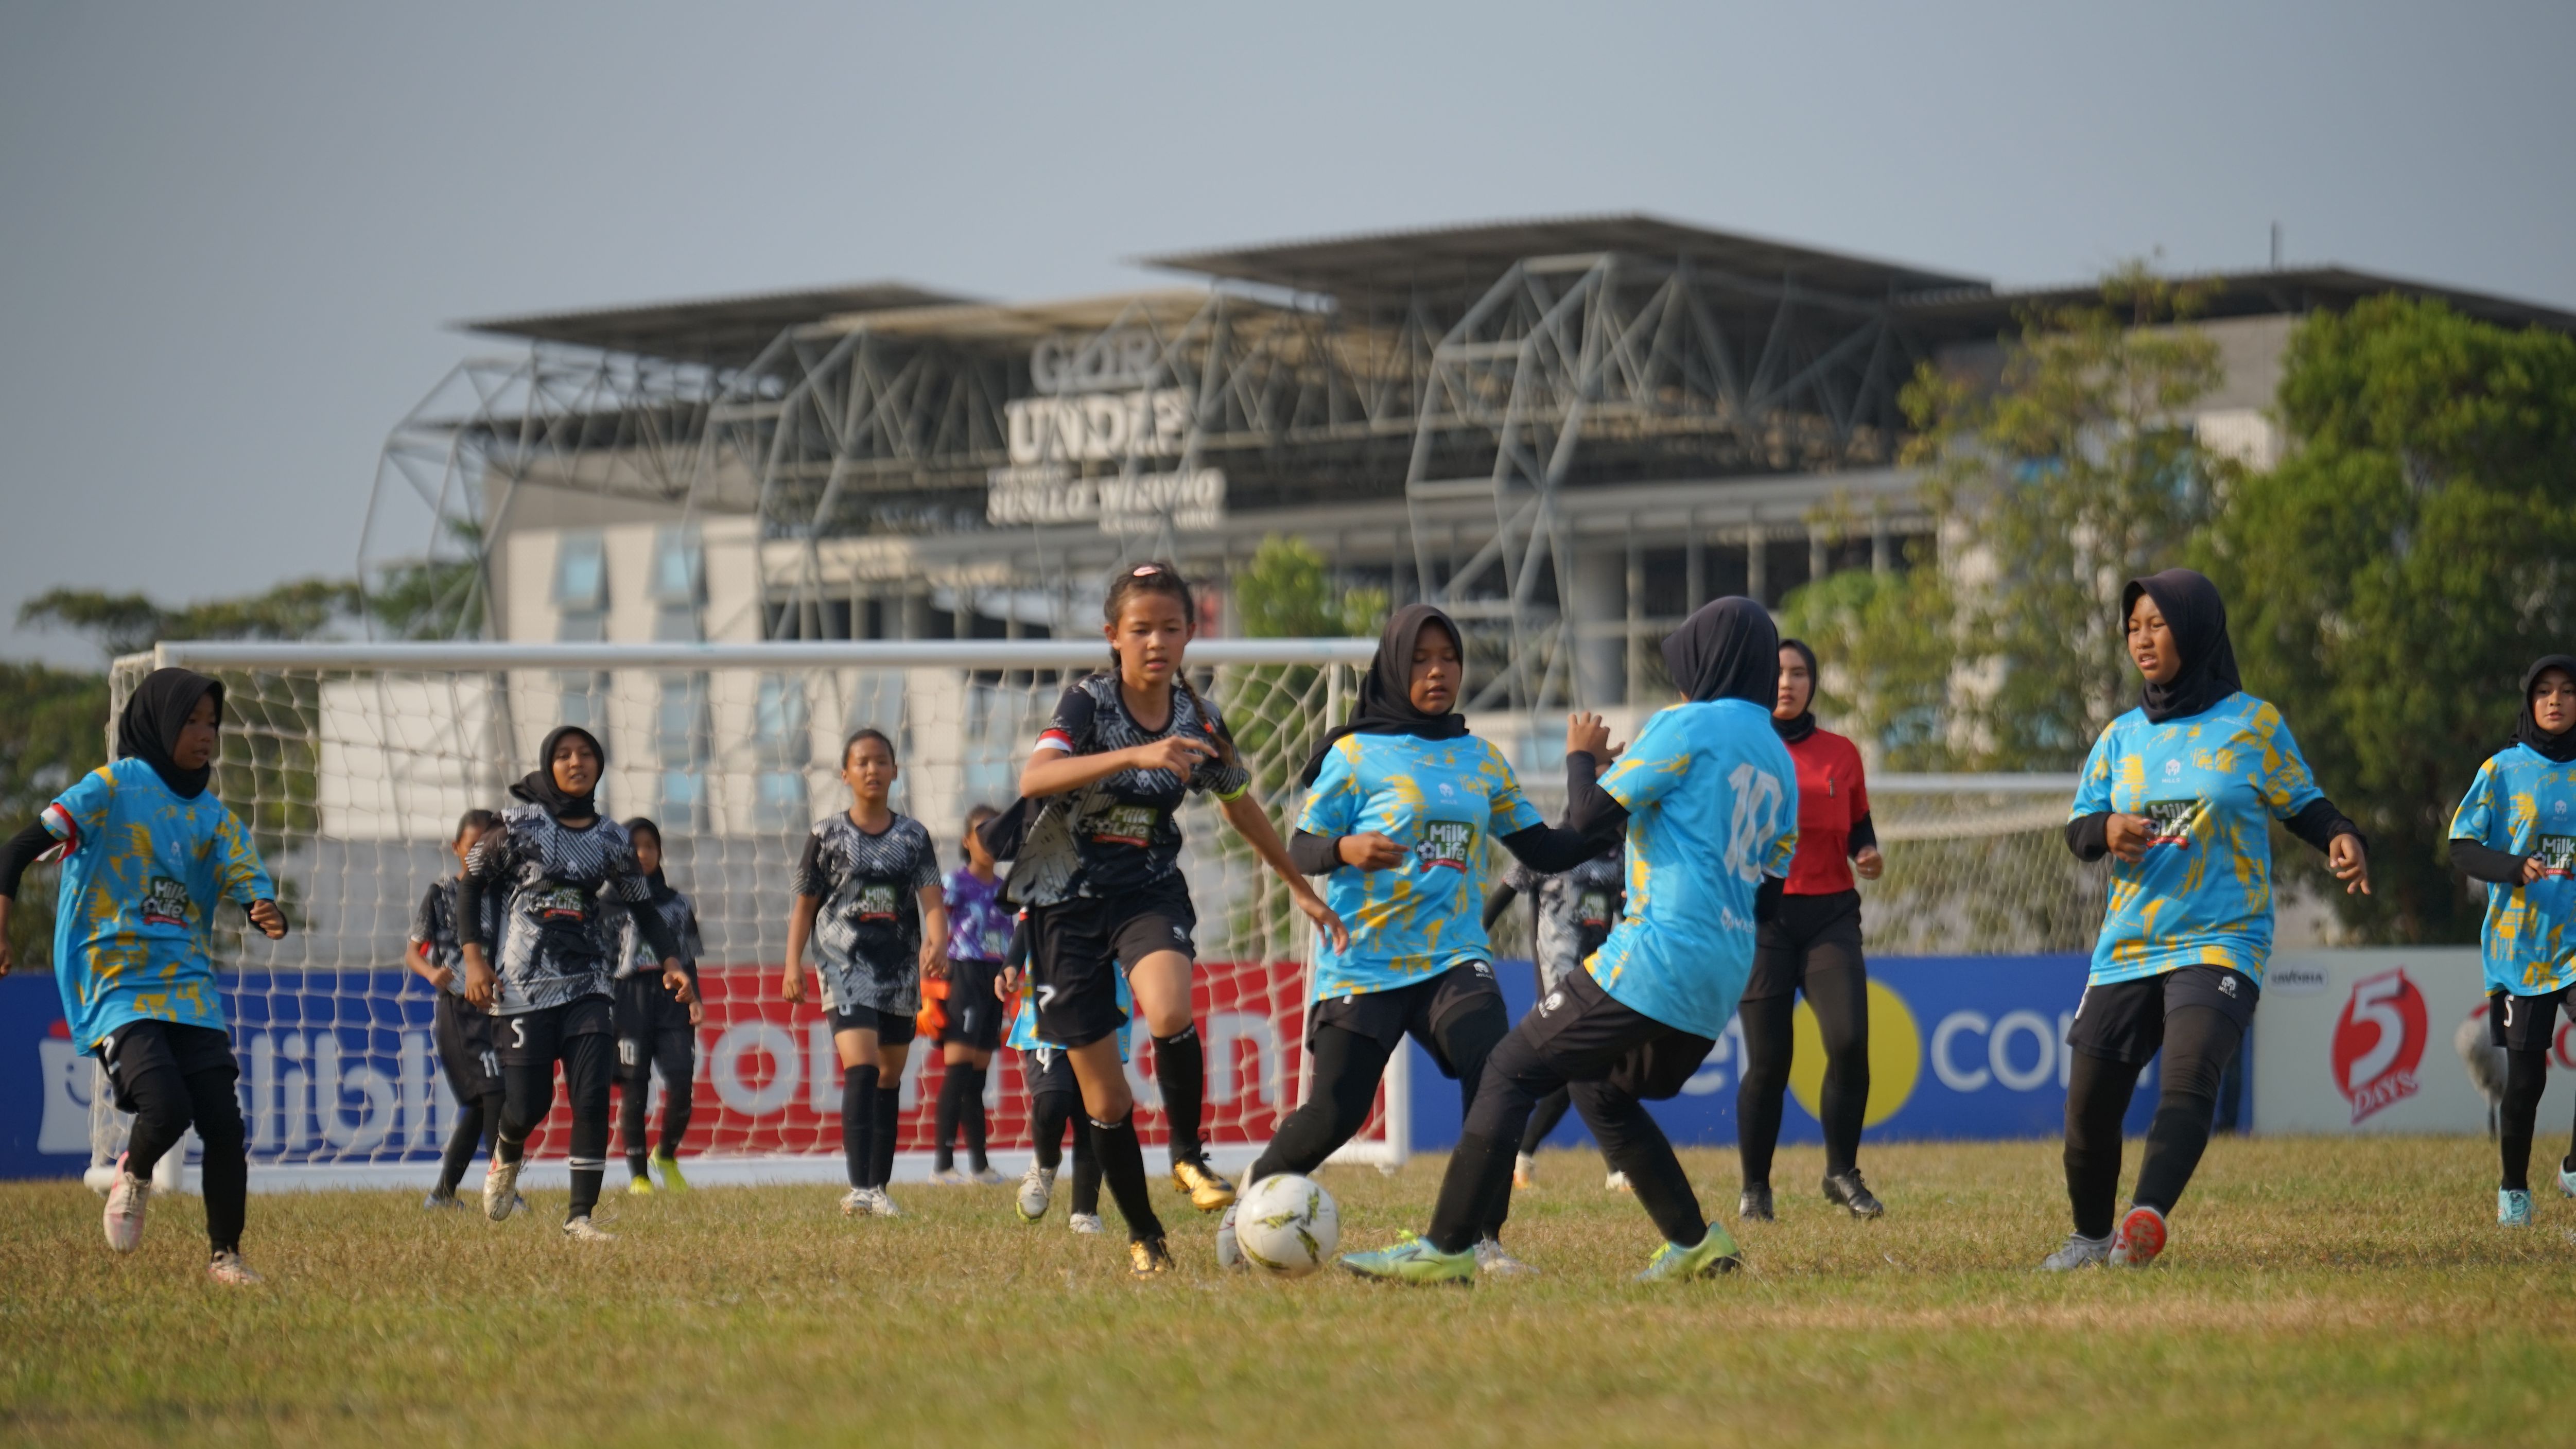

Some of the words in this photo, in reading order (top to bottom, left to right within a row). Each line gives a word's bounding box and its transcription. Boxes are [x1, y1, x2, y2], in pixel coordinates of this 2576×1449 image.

[1031, 328, 1157, 394] GOR
[1004, 385, 1195, 462] UNDIP
[1110, 808, 1150, 824] Milk
[1724, 762, 1783, 883] 10
[2150, 803, 2191, 819] Milk
[1111, 822, 1147, 838] Life
[1430, 825, 1468, 844] Milk
[1435, 842, 1465, 861] Life
[2542, 837, 2575, 853] Milk
[155, 881, 187, 902] Milk
[1036, 985, 1056, 1014] 7
[2218, 986, 2236, 999] MILLS
[962, 1007, 970, 1034] 1
[2503, 994, 2514, 1027] 5
[511, 1018, 524, 1049] 5
[2348, 974, 2405, 1091] 5
[479, 1050, 499, 1078] 11
[618, 1038, 636, 1067] 10
[2352, 1071, 2419, 1118] DAYS
